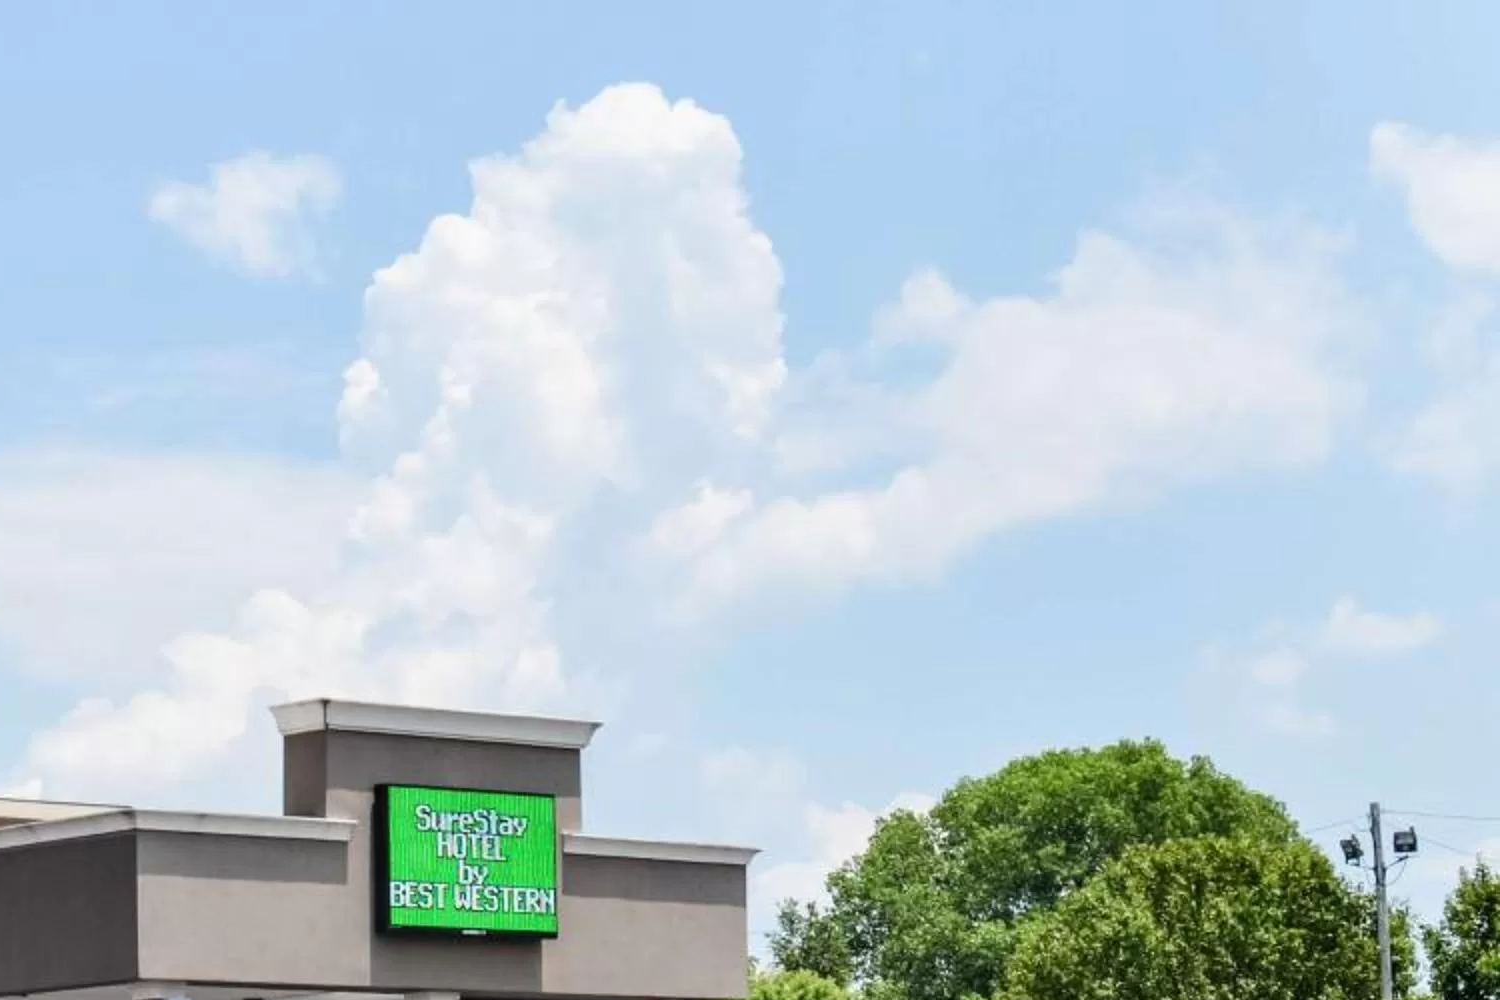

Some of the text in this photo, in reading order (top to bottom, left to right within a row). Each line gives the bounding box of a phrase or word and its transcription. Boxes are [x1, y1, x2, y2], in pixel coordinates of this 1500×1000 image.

[415, 804, 528, 836] SureStay
[437, 832, 506, 861] HOTEL
[458, 860, 489, 885] by
[389, 881, 555, 914] BEST WESTERN
